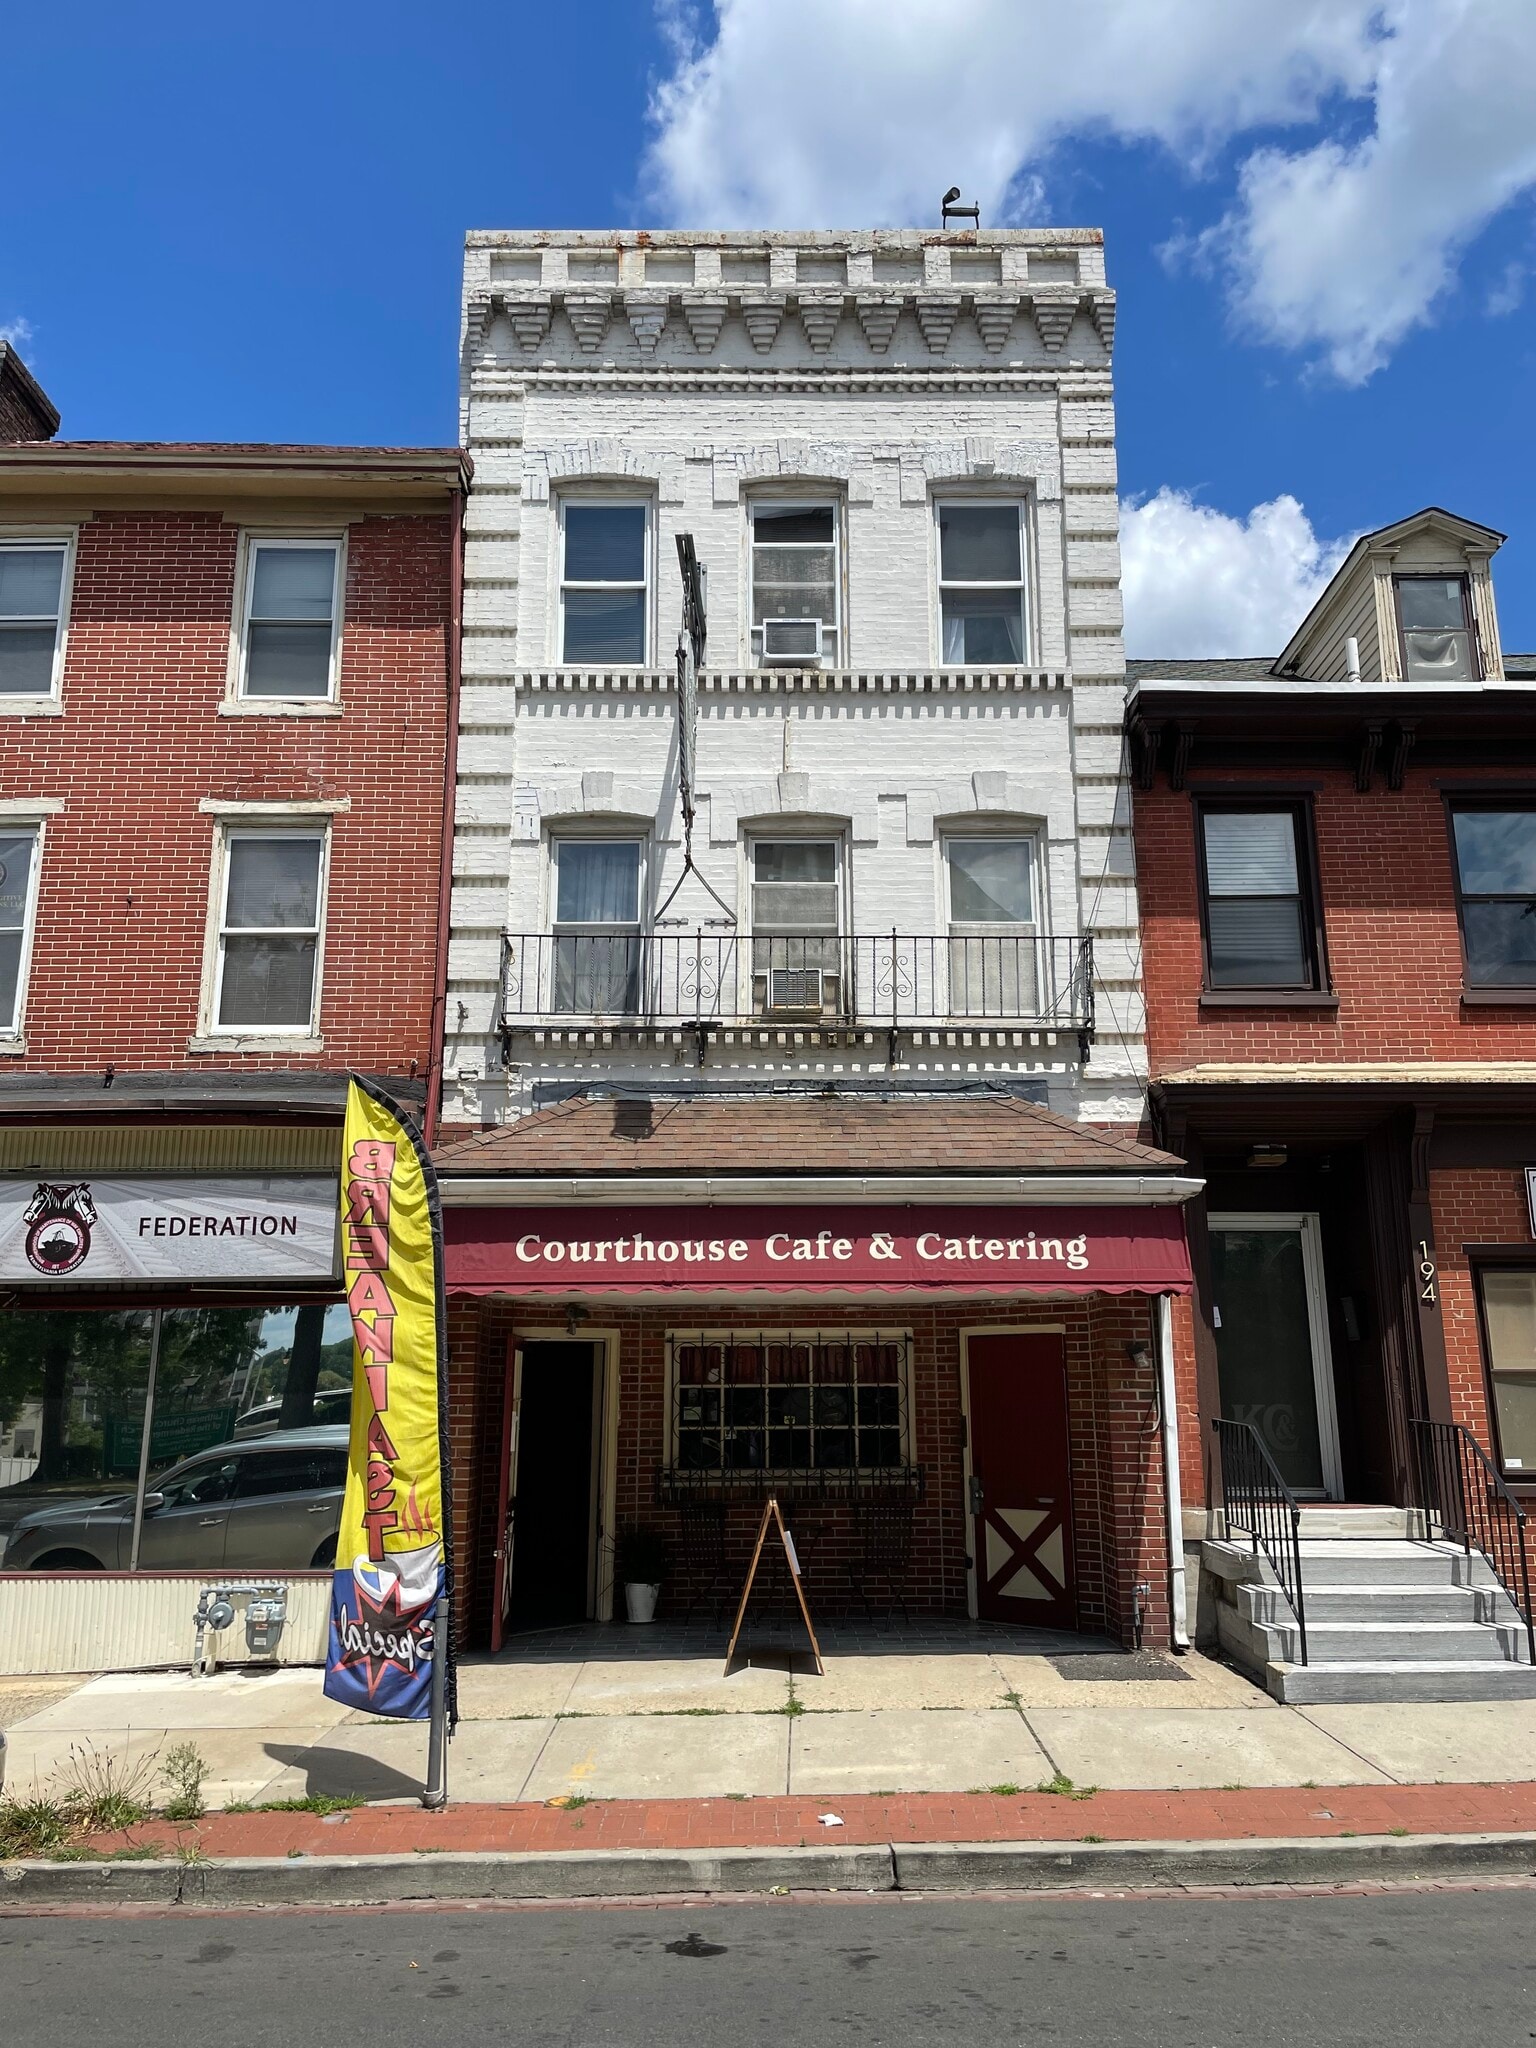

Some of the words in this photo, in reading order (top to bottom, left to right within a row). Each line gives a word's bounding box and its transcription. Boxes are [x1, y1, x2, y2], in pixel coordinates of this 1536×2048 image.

[138, 1215, 298, 1237] FEDERATION
[515, 1232, 749, 1263] Courthouse
[764, 1230, 853, 1261] Cafe
[868, 1232, 902, 1260] &
[915, 1230, 1090, 1271] Catering
[1419, 1240, 1437, 1302] 194
